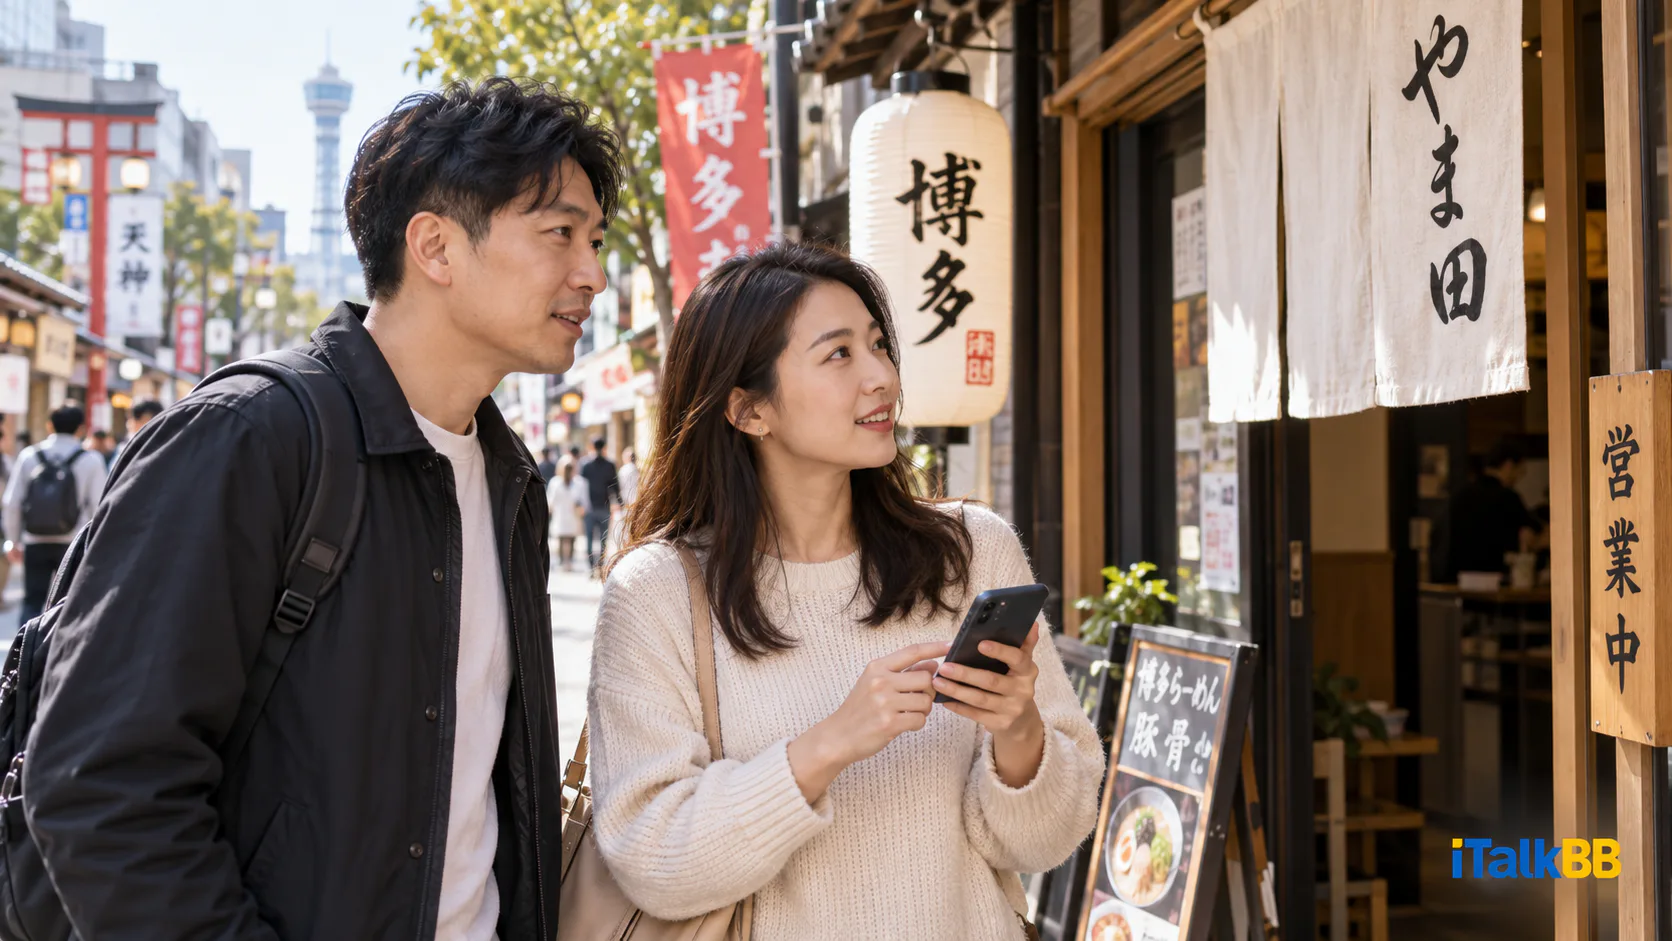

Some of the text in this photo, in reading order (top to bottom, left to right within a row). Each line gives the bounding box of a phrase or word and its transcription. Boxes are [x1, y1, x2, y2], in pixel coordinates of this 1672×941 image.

[1402, 14, 1487, 325] やま田
[119, 223, 150, 294] 天神
[896, 152, 984, 346] 博多
[1602, 423, 1641, 695] 営業中
[1128, 711, 1191, 773] 豚骨
[1137, 657, 1221, 714] 博多らーめん
